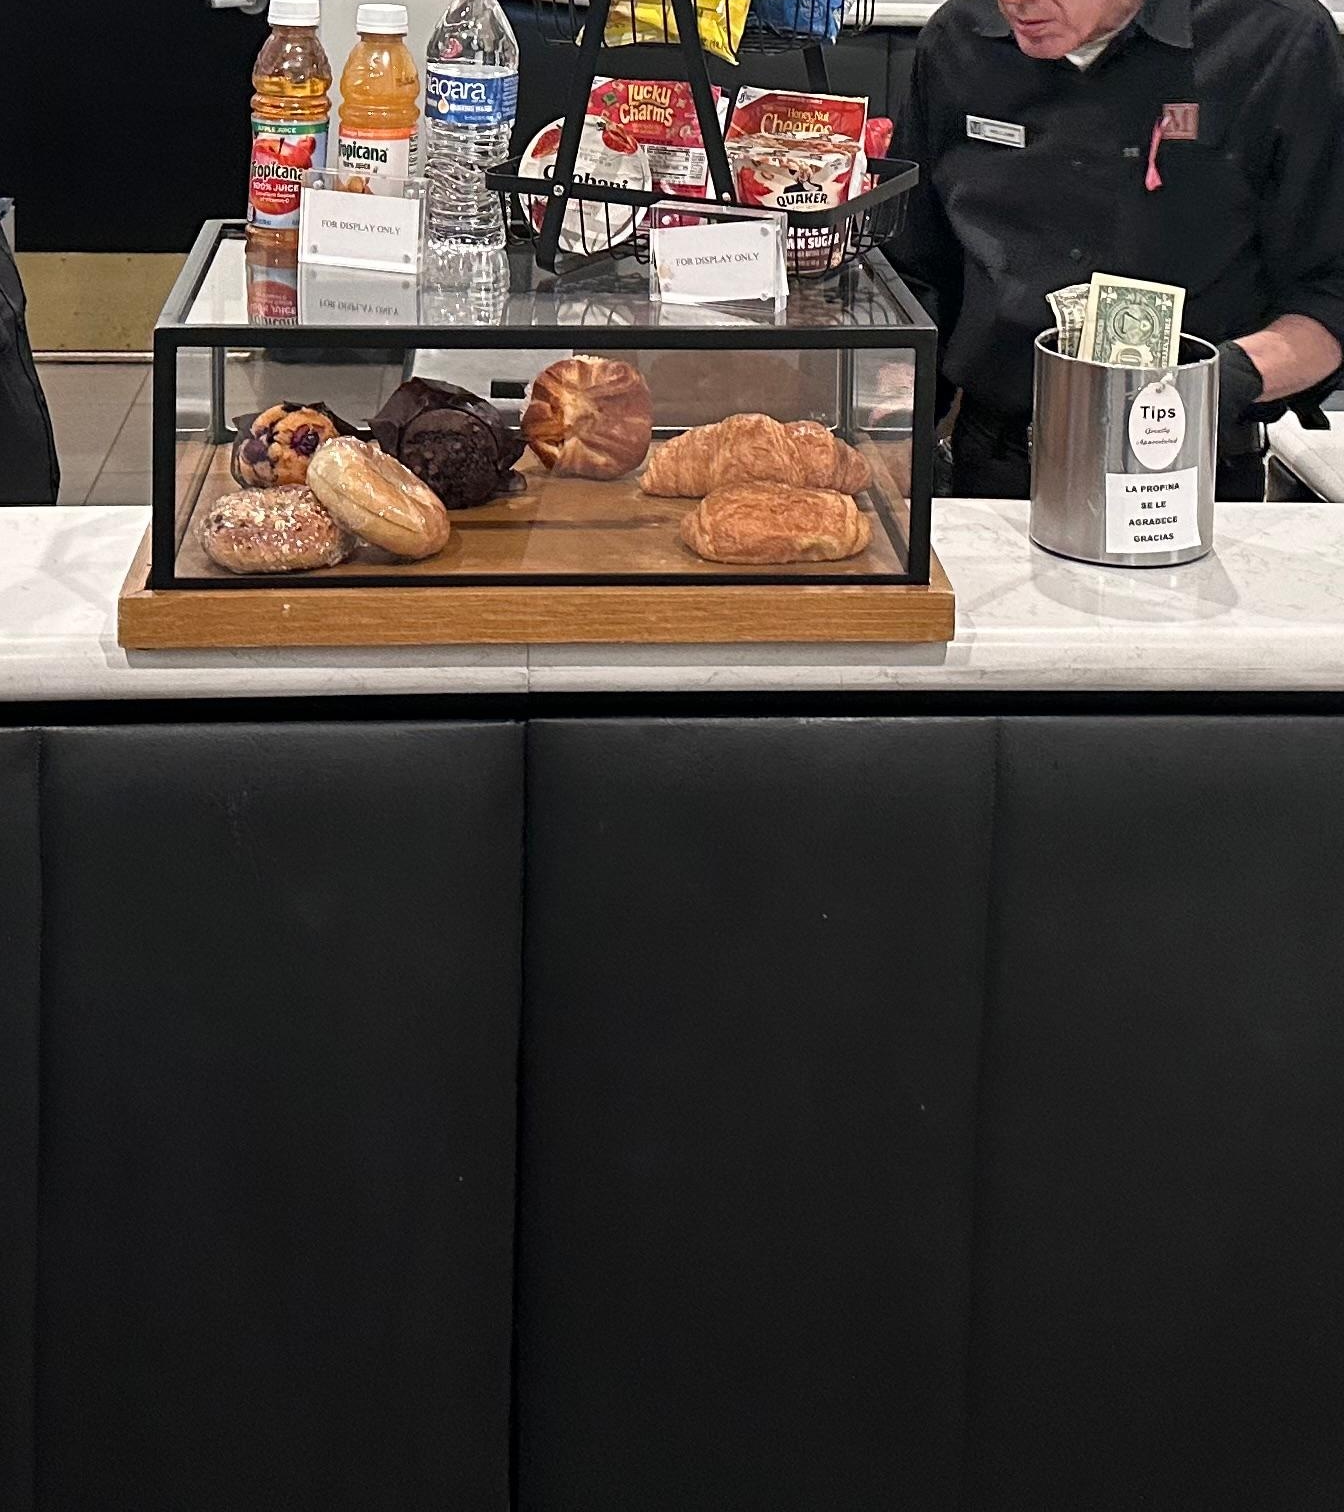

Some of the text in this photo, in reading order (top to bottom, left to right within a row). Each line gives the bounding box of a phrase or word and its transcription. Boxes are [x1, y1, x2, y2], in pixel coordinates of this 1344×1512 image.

[628, 84, 671, 107] Lucky
[619, 102, 674, 127] Charms
[788, 108, 830, 122] Honey Nut
[273, 183, 299, 192] JUICE
[776, 193, 828, 207] QUAKER
[321, 219, 401, 236] FOR DISPLAY ONLY
[676, 252, 760, 266] FOR DISPLAY ONLY
[1140, 405, 1176, 422] Tips
[1126, 482, 1180, 493] LA PROPINA
[1141, 500, 1167, 509] SE LE
[1128, 515, 1178, 527] AGRADECE
[1133, 532, 1174, 543] GRACIAS
